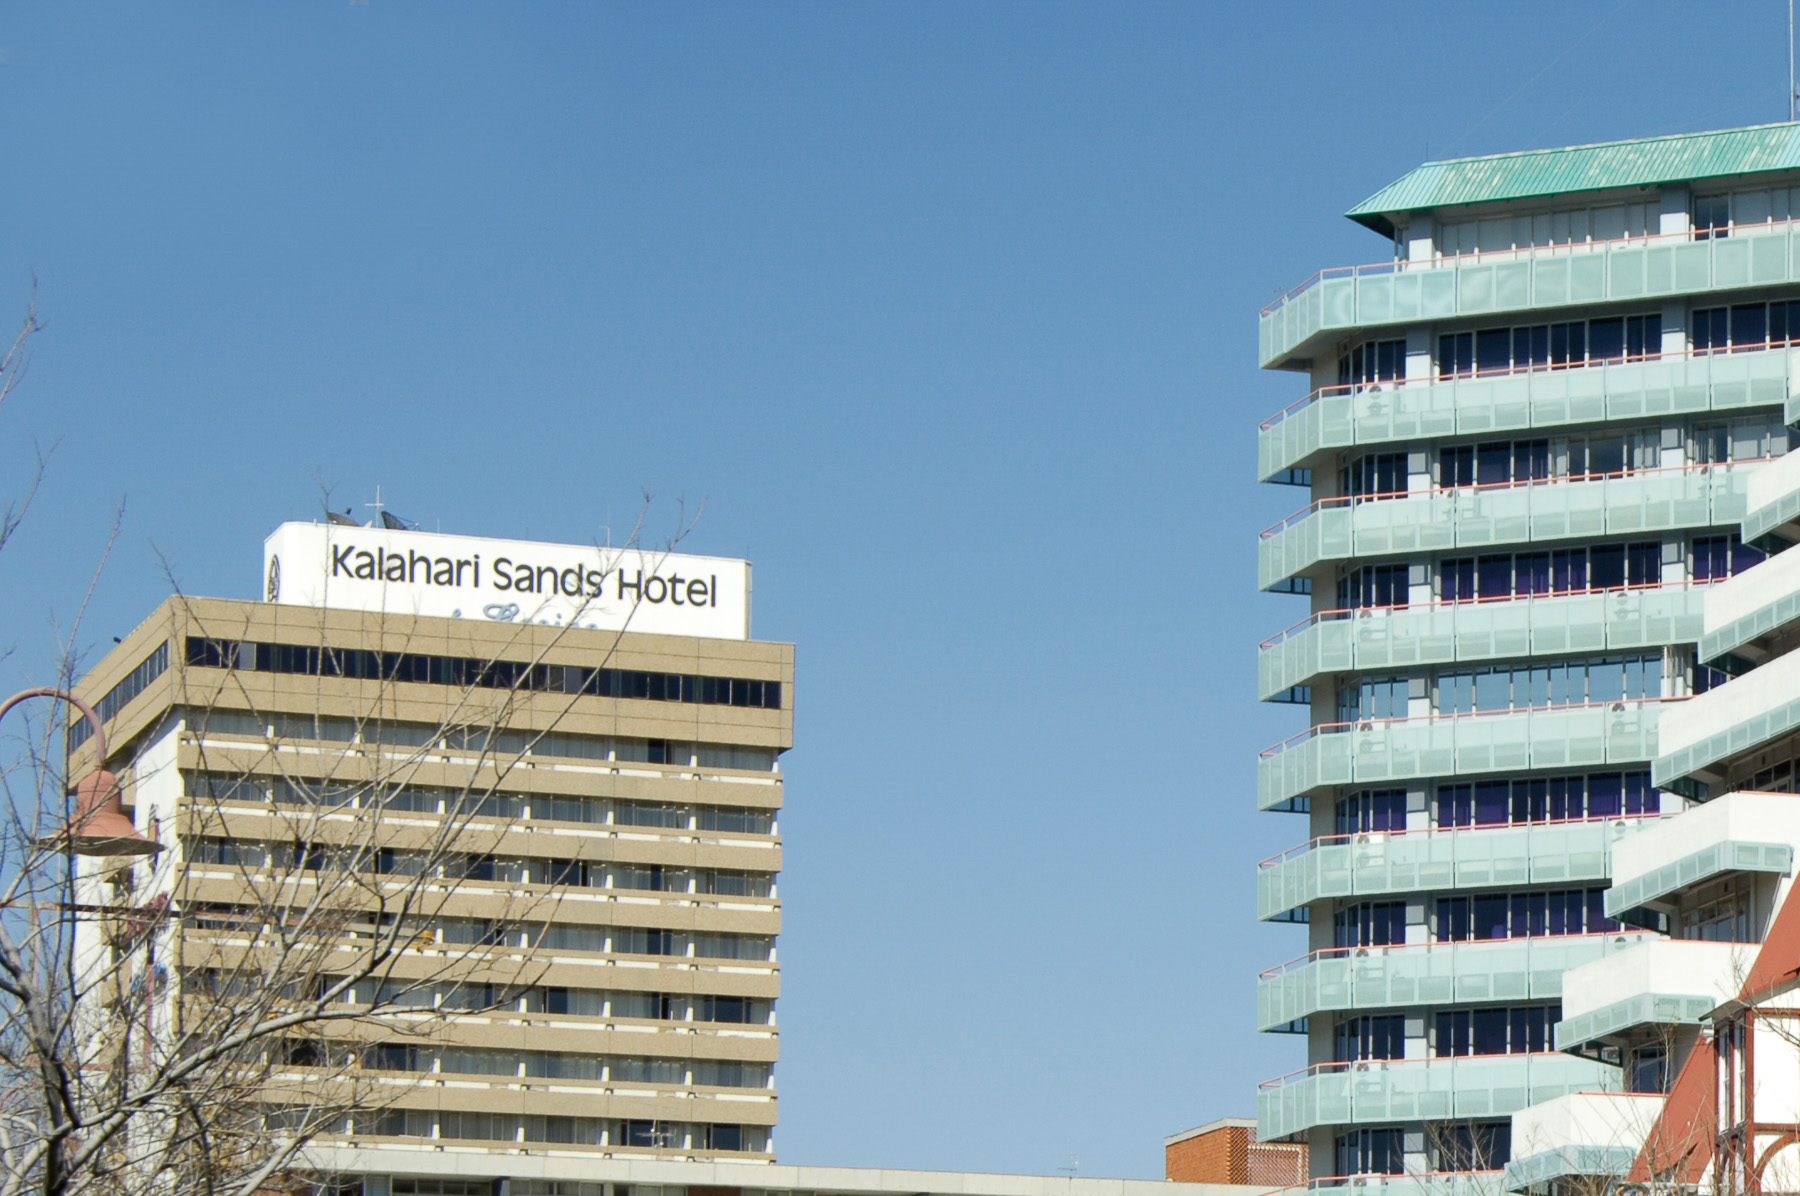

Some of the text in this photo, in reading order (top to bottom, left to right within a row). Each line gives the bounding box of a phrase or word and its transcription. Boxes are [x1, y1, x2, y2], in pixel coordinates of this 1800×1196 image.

[332, 543, 717, 608] Kalahari Sands Hotel
